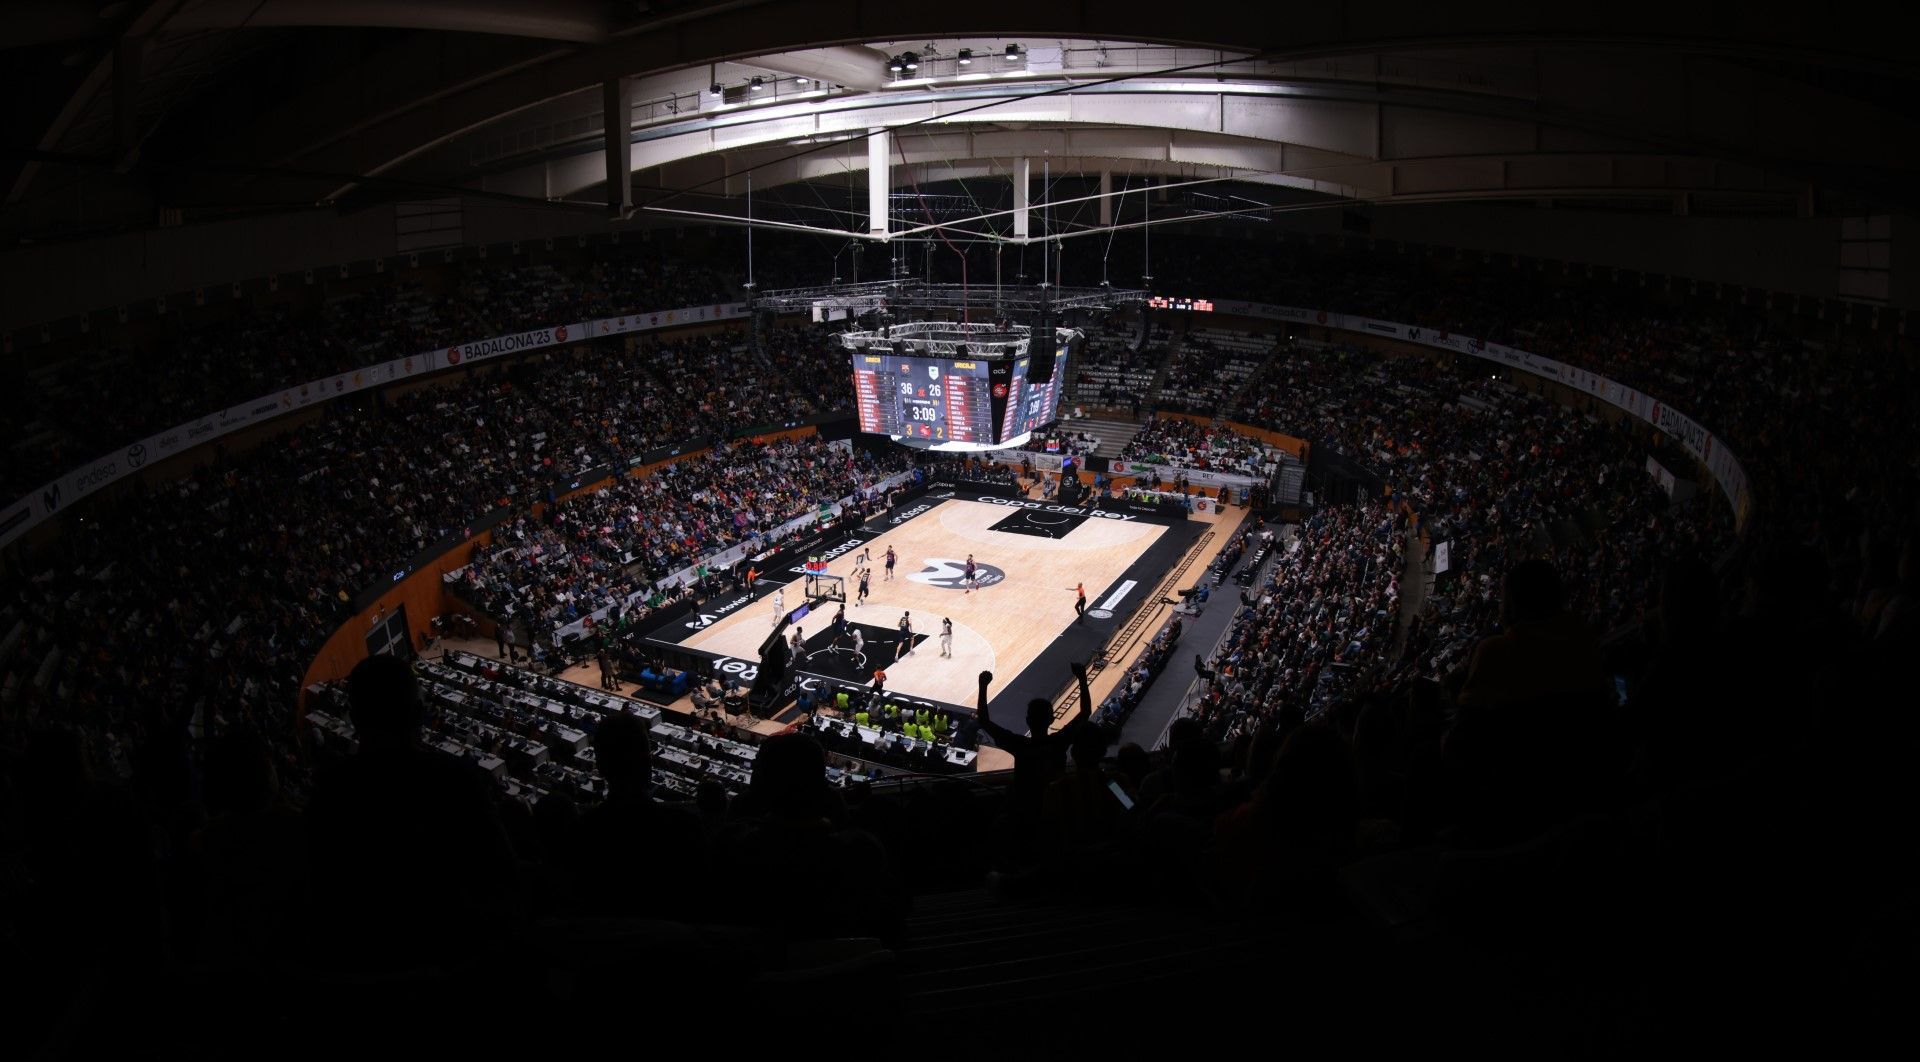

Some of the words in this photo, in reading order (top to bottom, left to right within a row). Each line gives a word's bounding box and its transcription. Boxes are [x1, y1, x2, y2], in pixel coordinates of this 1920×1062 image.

[465, 330, 551, 360] BADALONA'23
[900, 382, 913, 395] 36
[928, 384, 941, 397] 26
[912, 406, 936, 422] 3:09
[906, 424, 913, 436] 3
[936, 427, 943, 439] 2
[977, 496, 1042, 509] Copa
[1046, 505, 1086, 514] del
[1090, 509, 1137, 521] Rey
